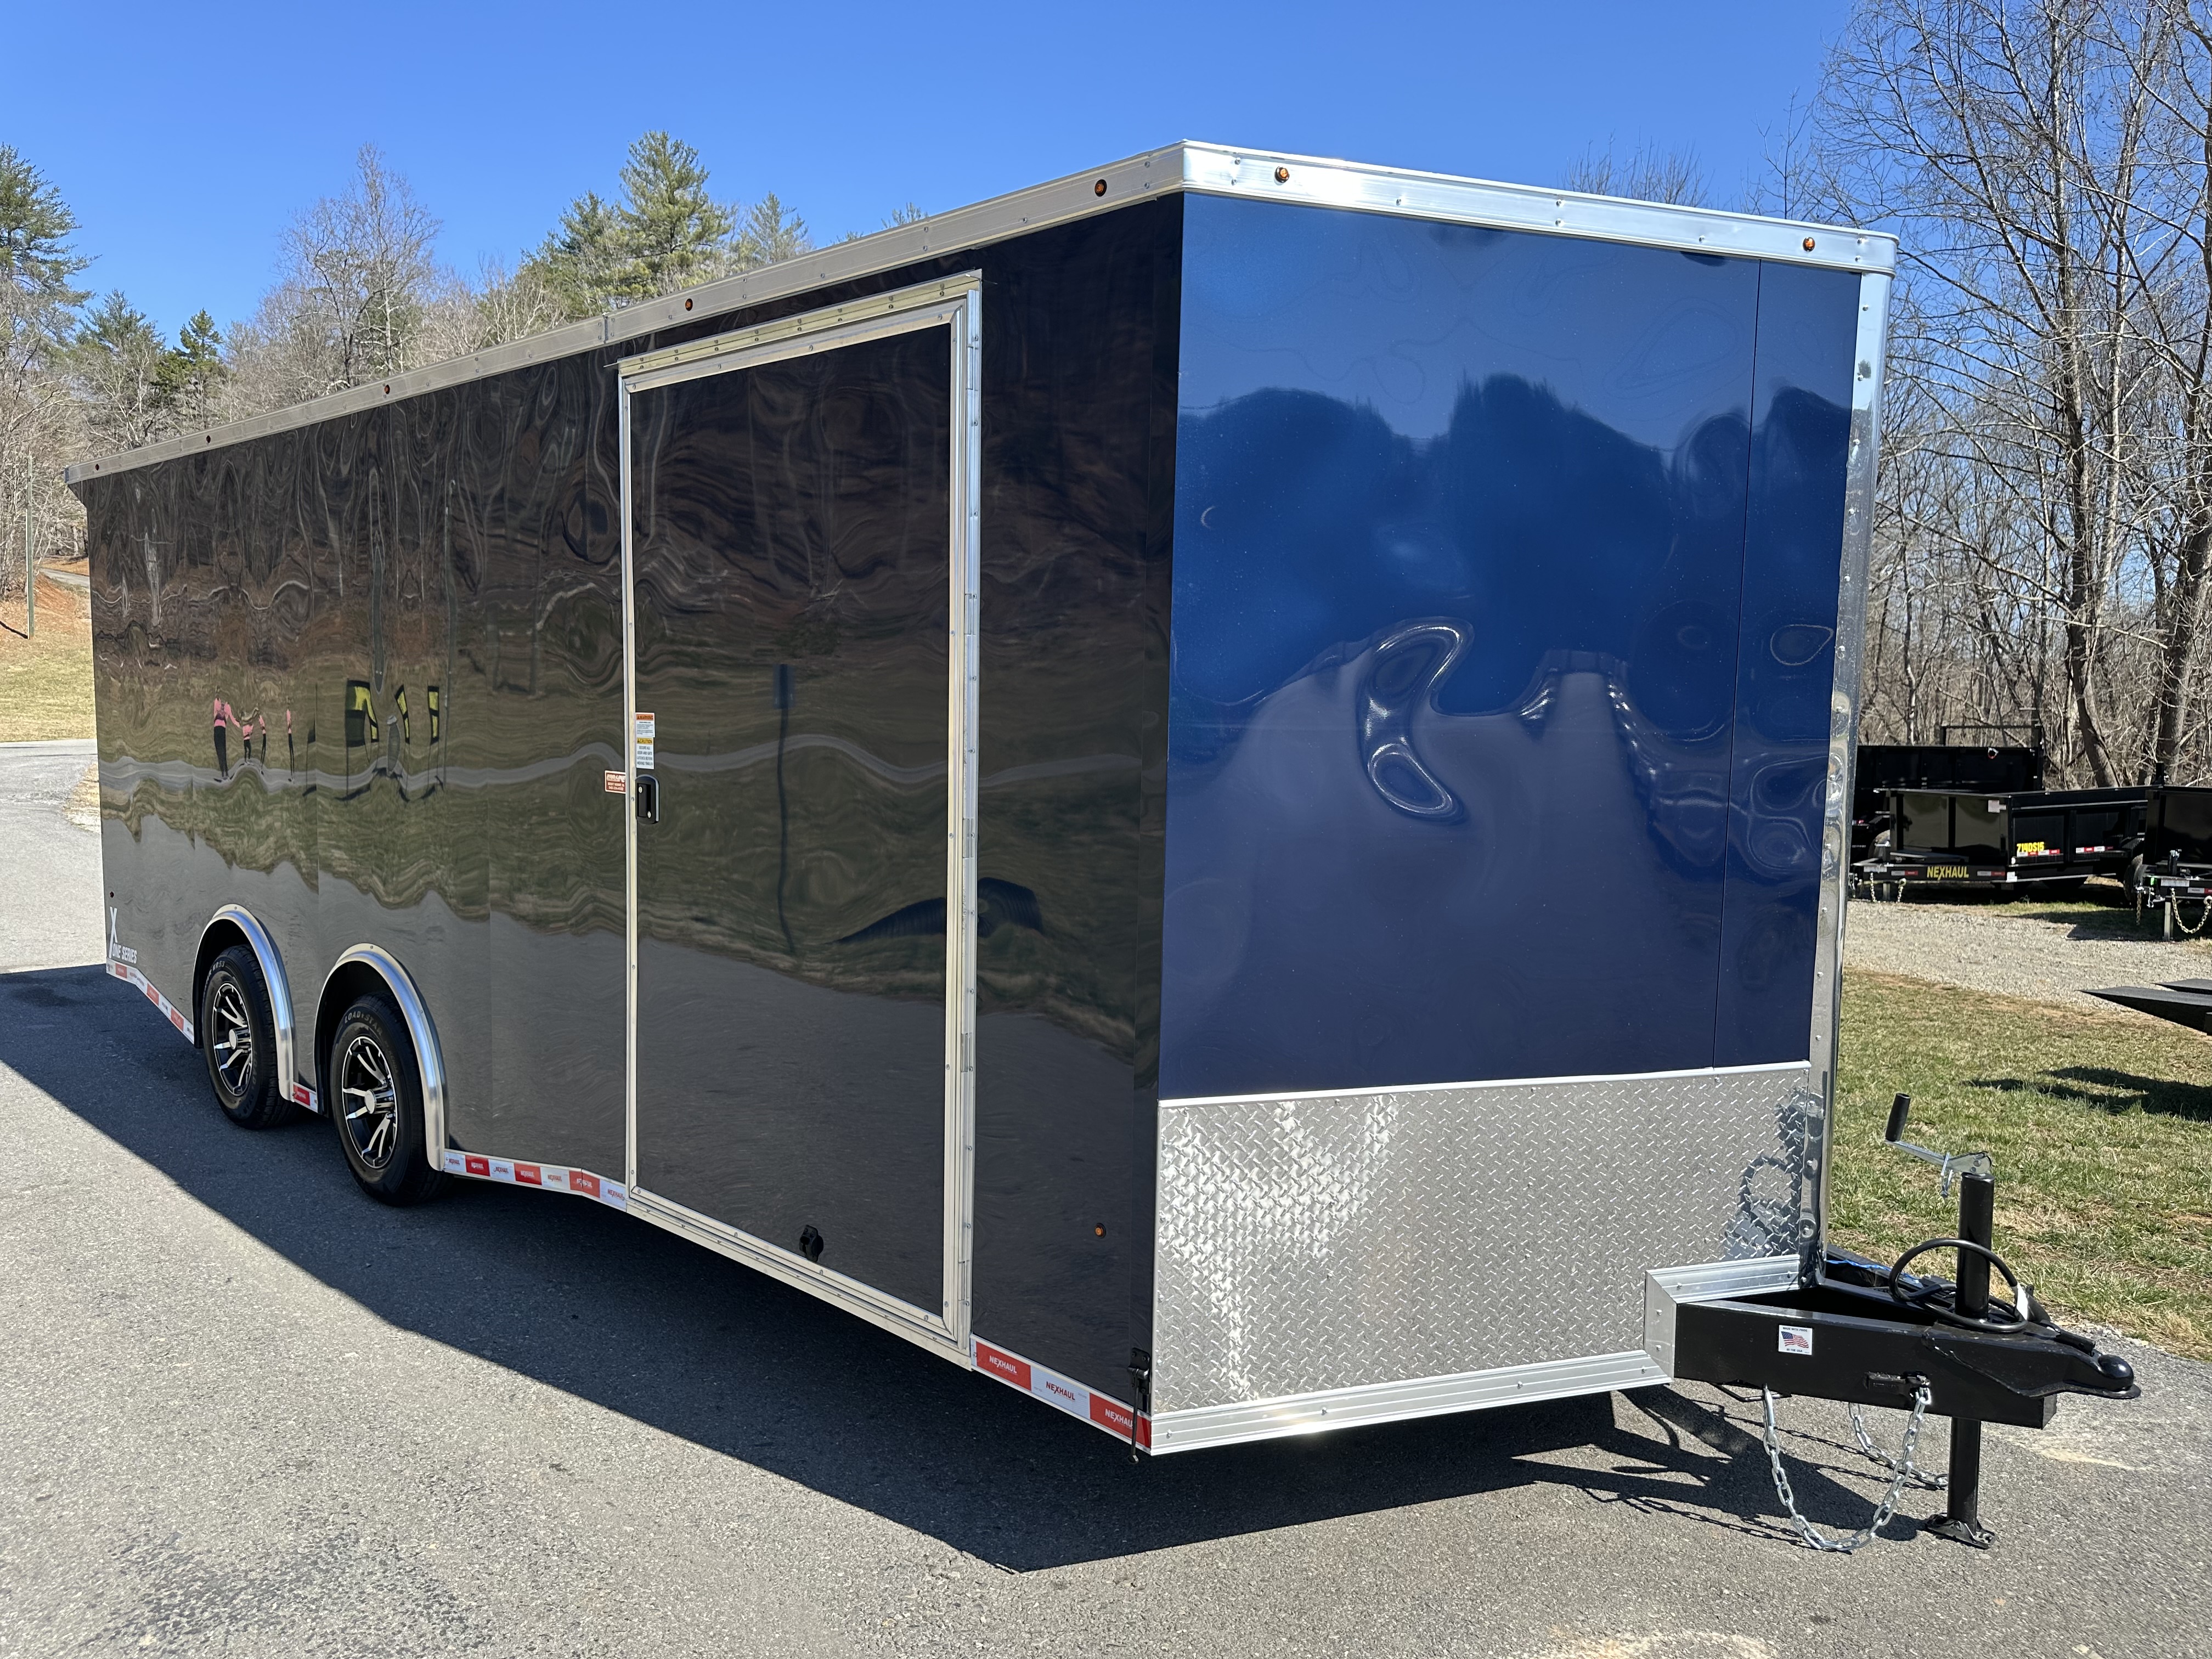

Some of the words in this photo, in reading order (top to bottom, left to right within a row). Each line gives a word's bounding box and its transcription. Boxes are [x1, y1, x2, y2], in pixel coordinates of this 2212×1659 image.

[1927, 866, 1969, 881] NEXHAUL
[109, 906, 118, 958] X
[112, 943, 121, 958] ONE
[122, 946, 137, 964] SERIES
[345, 1011, 361, 1024] LOAD
[364, 1014, 382, 1036] STAR
[989, 1355, 1017, 1374] NEXHAUL
[1046, 1381, 1075, 1401] NEXHAUL
[1105, 1408, 1133, 1429] NEXHAU
